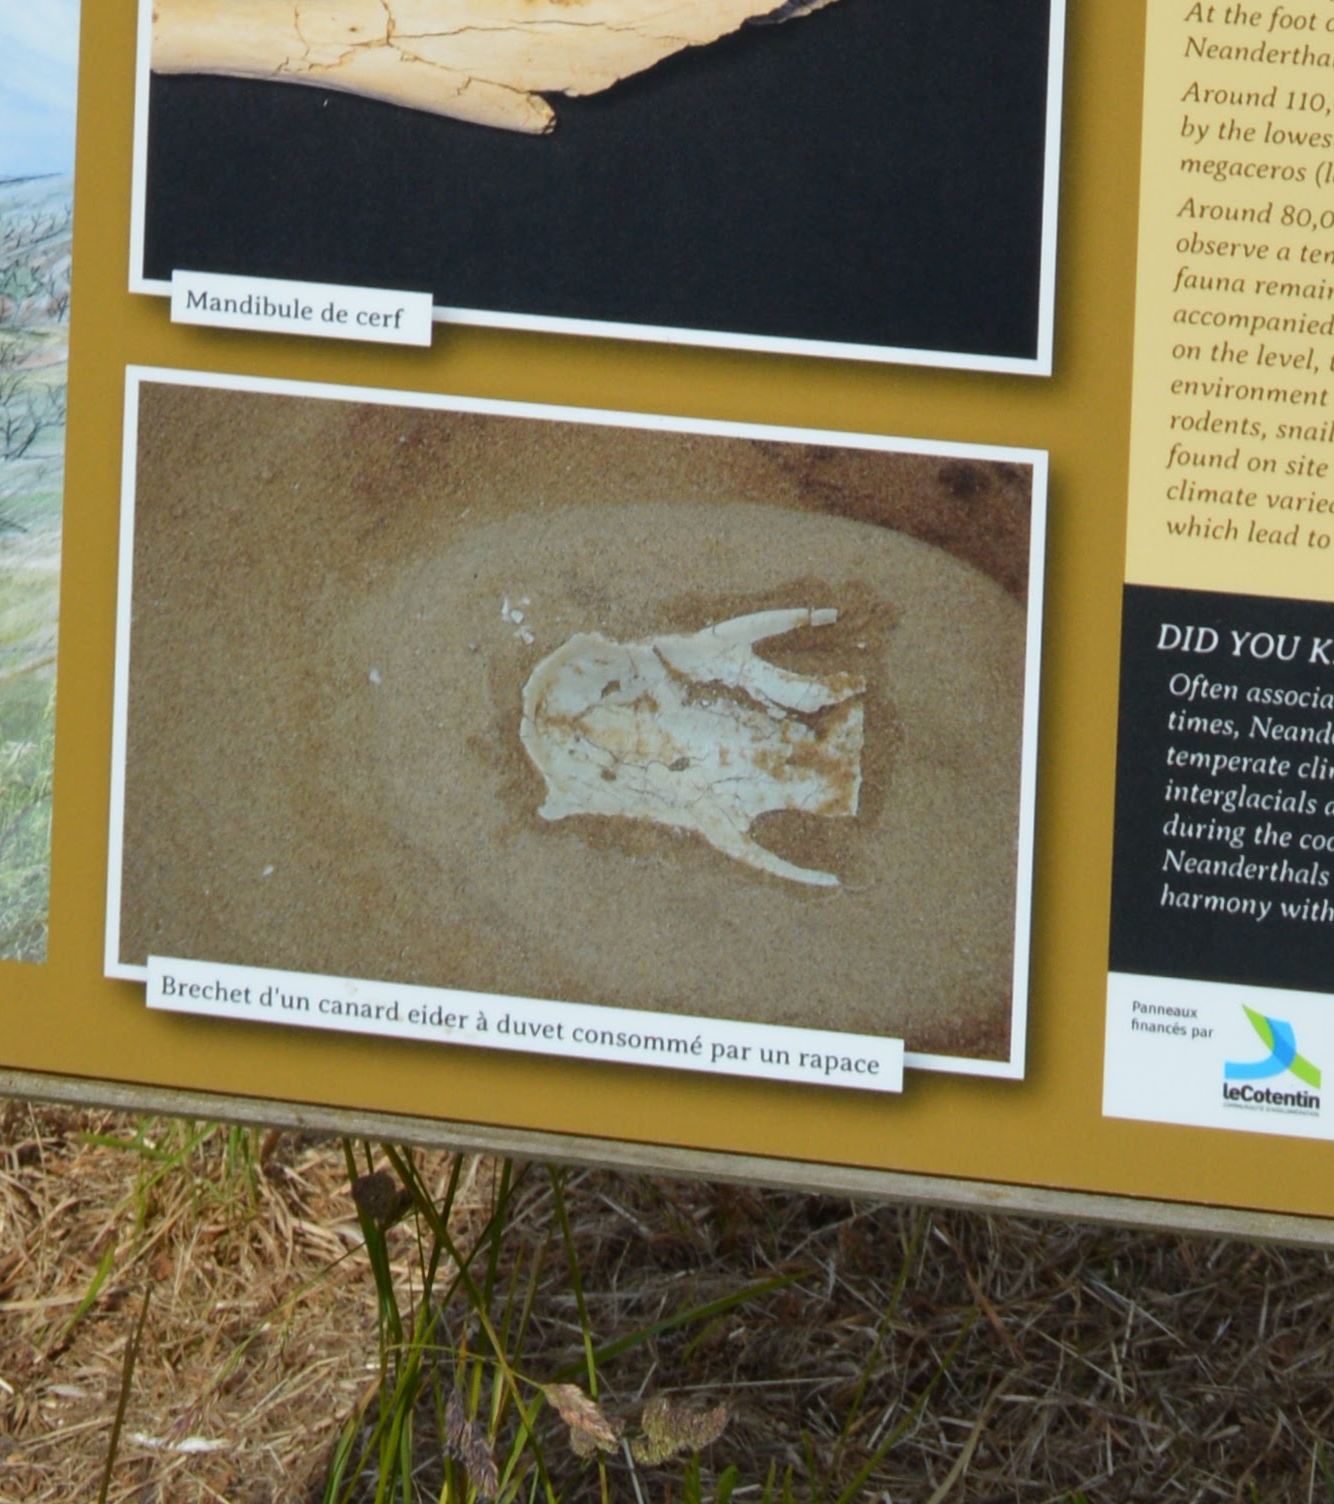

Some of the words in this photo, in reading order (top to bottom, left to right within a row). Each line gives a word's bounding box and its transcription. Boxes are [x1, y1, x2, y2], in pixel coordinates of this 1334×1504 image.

[186, 290, 313, 320] Mandibule
[321, 302, 348, 323] de
[356, 308, 404, 329] cerf
[1157, 624, 1219, 653] DID
[1231, 631, 1301, 660] YOU
[1160, 883, 1272, 922] harmony
[1281, 898, 1334, 922] with
[162, 975, 250, 1004] Brechet
[259, 986, 309, 1011] d'un
[318, 999, 399, 1021] canard
[408, 1005, 468, 1029] eider
[476, 1011, 488, 1031] à
[497, 1014, 563, 1040] duvet
[572, 1028, 702, 1055] consommé
[711, 1043, 751, 1063] par
[760, 1048, 790, 1065] un
[799, 1053, 879, 1076] rapace
[1132, 1000, 1198, 1019] Panneaux
[1131, 1018, 1188, 1037] financés
[1191, 1025, 1214, 1040] par
[1223, 1082, 1321, 1109] leCotentin
